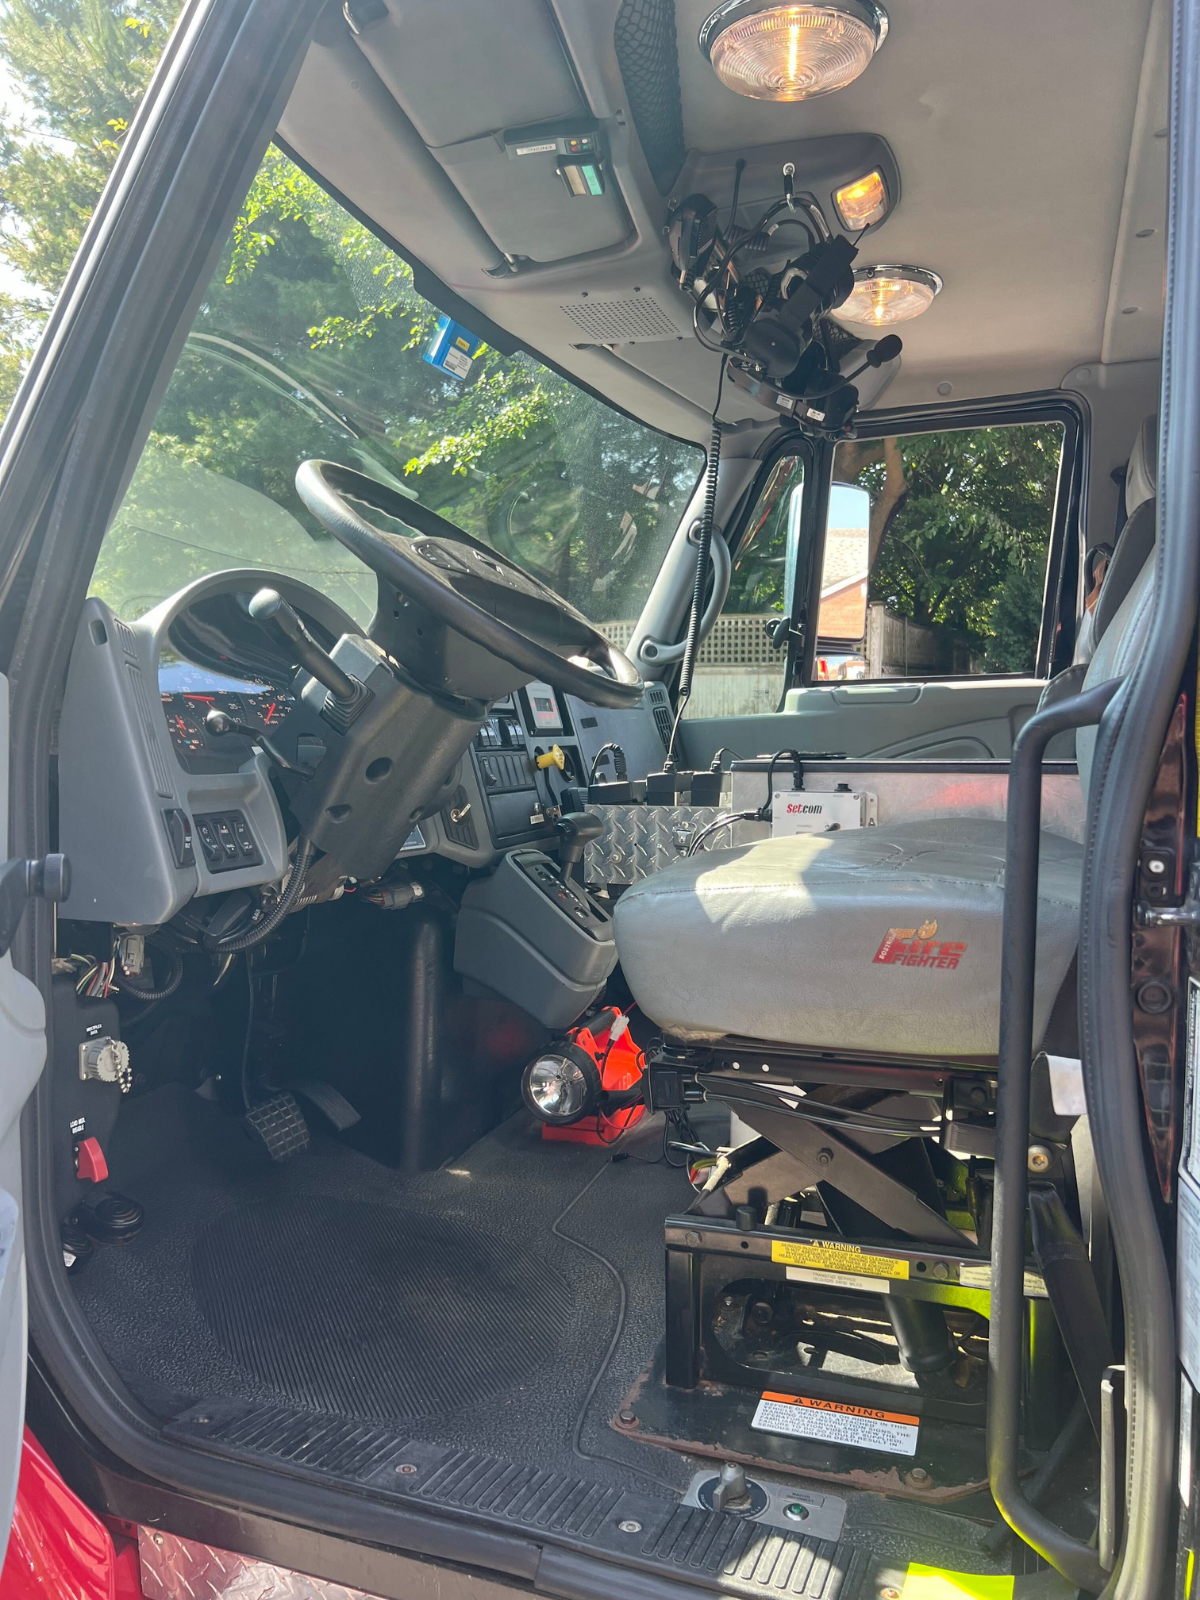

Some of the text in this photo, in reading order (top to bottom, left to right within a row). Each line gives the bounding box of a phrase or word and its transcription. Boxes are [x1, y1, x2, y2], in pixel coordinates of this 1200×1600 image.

[787, 804, 822, 814] setcom
[893, 954, 960, 970] FIGHTER
[822, 1240, 861, 1253] WARNING
[794, 1406, 836, 1417] OPERATING
[808, 1399, 885, 1418] WARNING
[762, 1408, 796, 1417] WARNING
[815, 1418, 866, 1429] INSTRUCTION
[835, 1417, 874, 1427] ATTACHED
